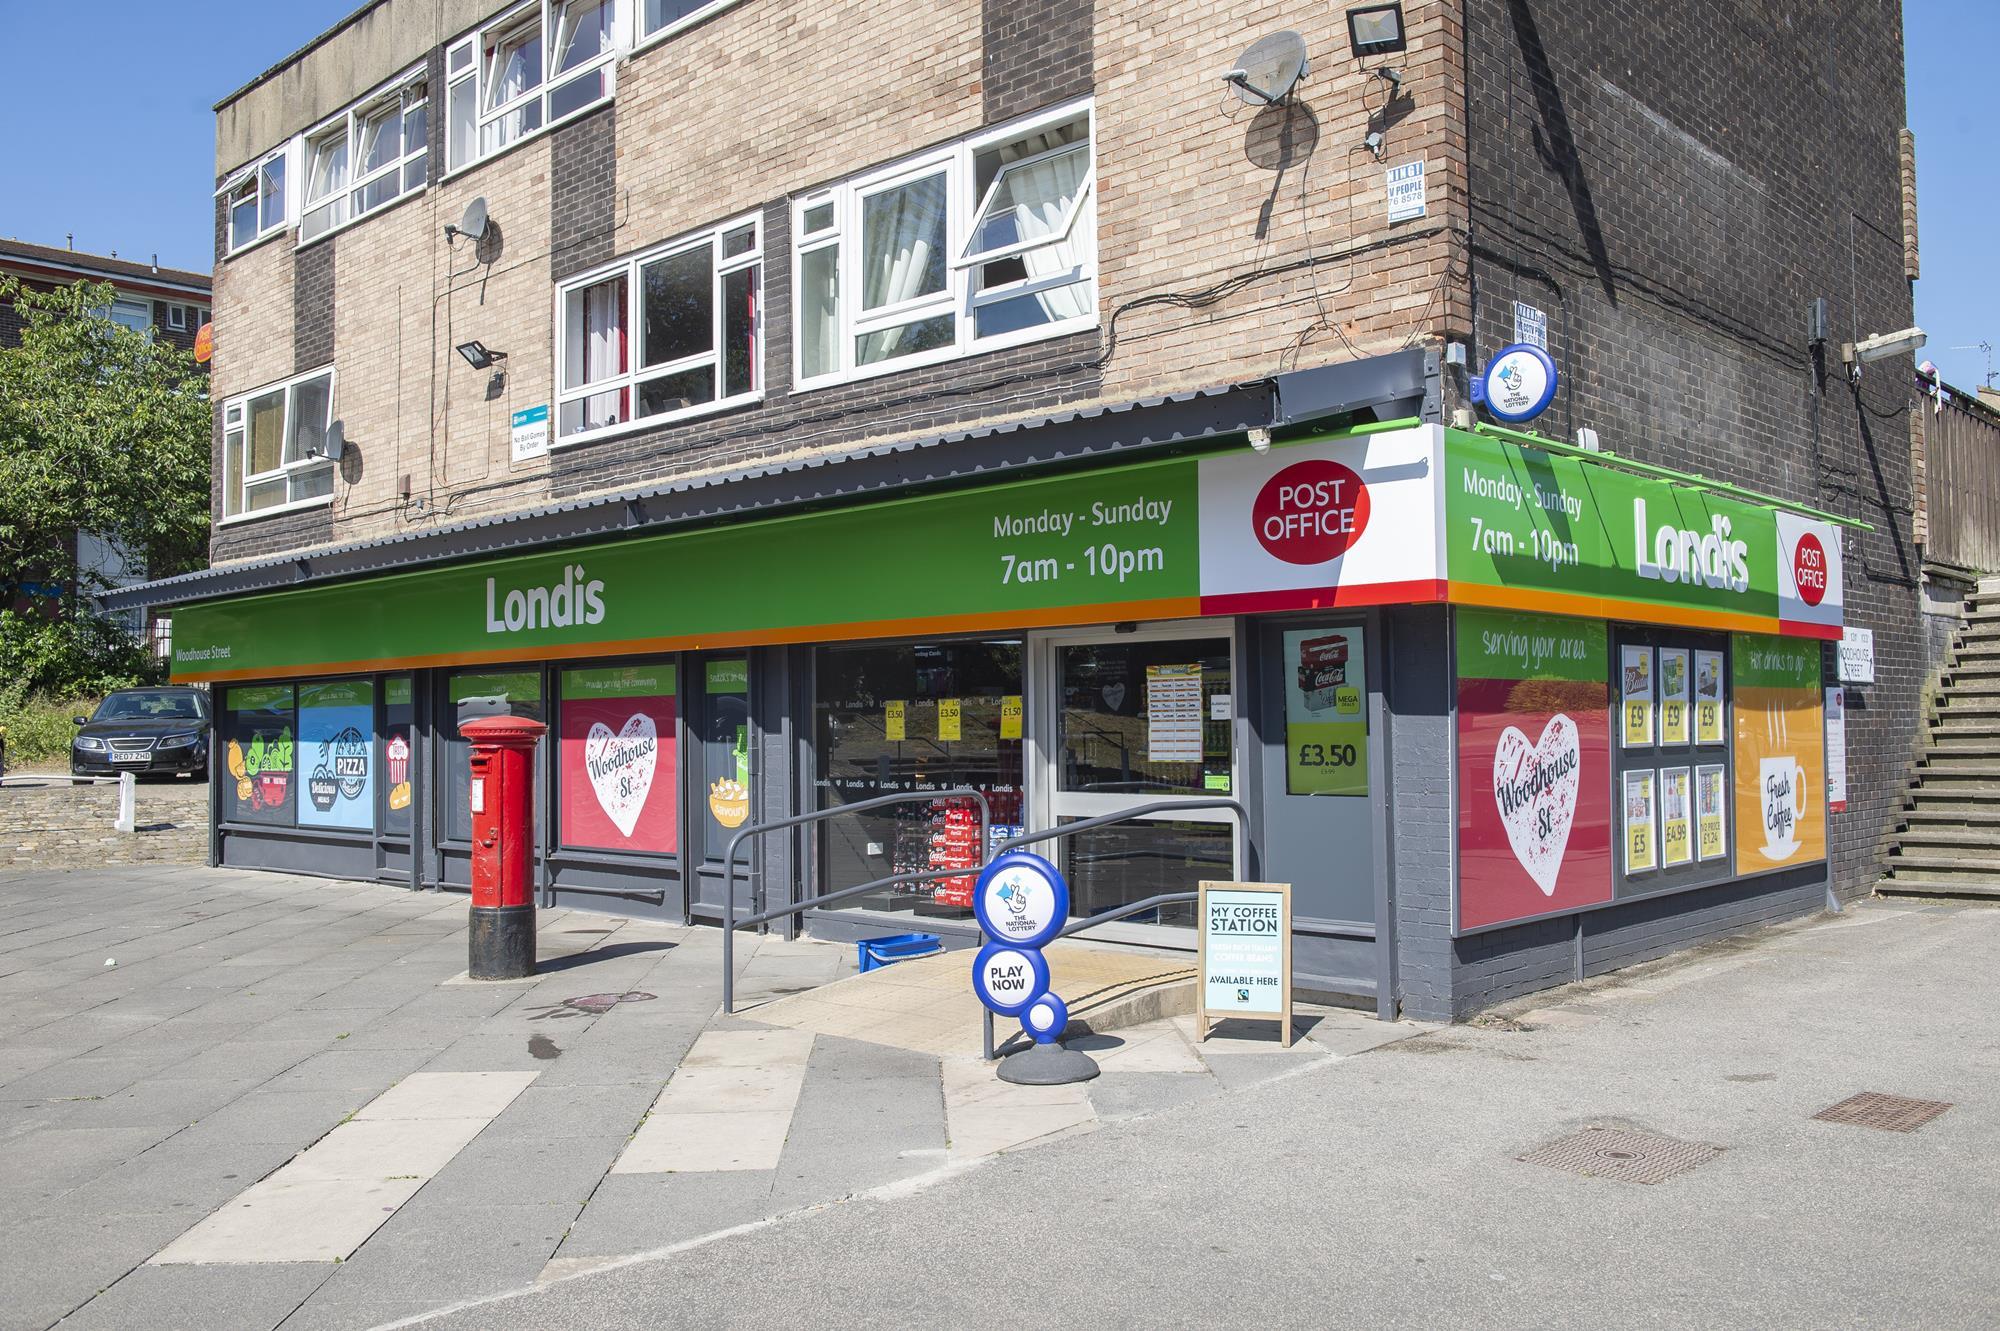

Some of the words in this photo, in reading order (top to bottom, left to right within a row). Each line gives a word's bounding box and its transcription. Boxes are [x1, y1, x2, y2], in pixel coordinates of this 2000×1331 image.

[1396, 180, 1422, 196] PEOPLE
[1401, 191, 1422, 204] 8578
[1504, 395, 1529, 404] NATIONAL
[1505, 400, 1529, 409] LOTTERY
[521, 433, 529, 442] Ball
[530, 431, 545, 440] Games
[527, 441, 539, 450] Order
[1279, 479, 1345, 511] POST
[1464, 467, 1522, 510] Monday
[1534, 482, 1581, 522] Sunday
[994, 509, 1074, 538] Monday
[1092, 496, 1173, 526] Sunday
[1263, 508, 1356, 541] OFFICE
[1470, 517, 1514, 556] 7am
[1530, 528, 1579, 572] 10pm
[1634, 497, 1749, 593] Londis
[1001, 555, 1058, 585] 7am
[1084, 543, 1164, 583] 10pm
[1801, 547, 1820, 567] POST
[1797, 569, 1824, 589] OFFICE
[486, 564, 606, 633] Londis
[176, 648, 210, 662] Woodhouse
[211, 645, 231, 660] Street
[1532, 636, 1556, 669] your
[1560, 638, 1587, 660] area
[1764, 651, 1785, 671] drinks
[1787, 653, 1793, 671] to
[888, 710, 903, 718] £3.50
[940, 708, 959, 717] £3.50
[1003, 707, 1021, 716] £1.50
[1631, 705, 1643, 728] £9
[1667, 705, 1680, 727] £9
[1702, 705, 1714, 727] £9
[588, 738, 656, 780] Woodhouse
[1299, 744, 1357, 767] £3.50
[337, 758, 365, 775] PIZZA
[620, 777, 632, 798] St
[846, 780, 864, 788] Londis
[880, 781, 899, 789] Londis
[915, 782, 935, 790] Londis
[952, 783, 973, 791] Londis
[992, 784, 1013, 792] Londis
[1497, 748, 1577, 817] Woodhouse
[1766, 771, 1791, 801] Fresh
[1538, 805, 1552, 840] St
[1708, 821, 1720, 831] PRICE
[1767, 800, 1792, 839] Coffee
[1666, 824, 1686, 843] £4.99
[1703, 832, 1718, 845] £1.24
[1634, 834, 1646, 854] £5
[1211, 907, 1229, 917] MY
[1233, 907, 1277, 918] COFFEE
[1211, 918, 1277, 932] STATION
[991, 965, 1024, 979] PLAY
[1209, 976, 1254, 985] AVAILABLE
[1256, 977, 1278, 986] HERE
[992, 979, 1025, 991] NOW
